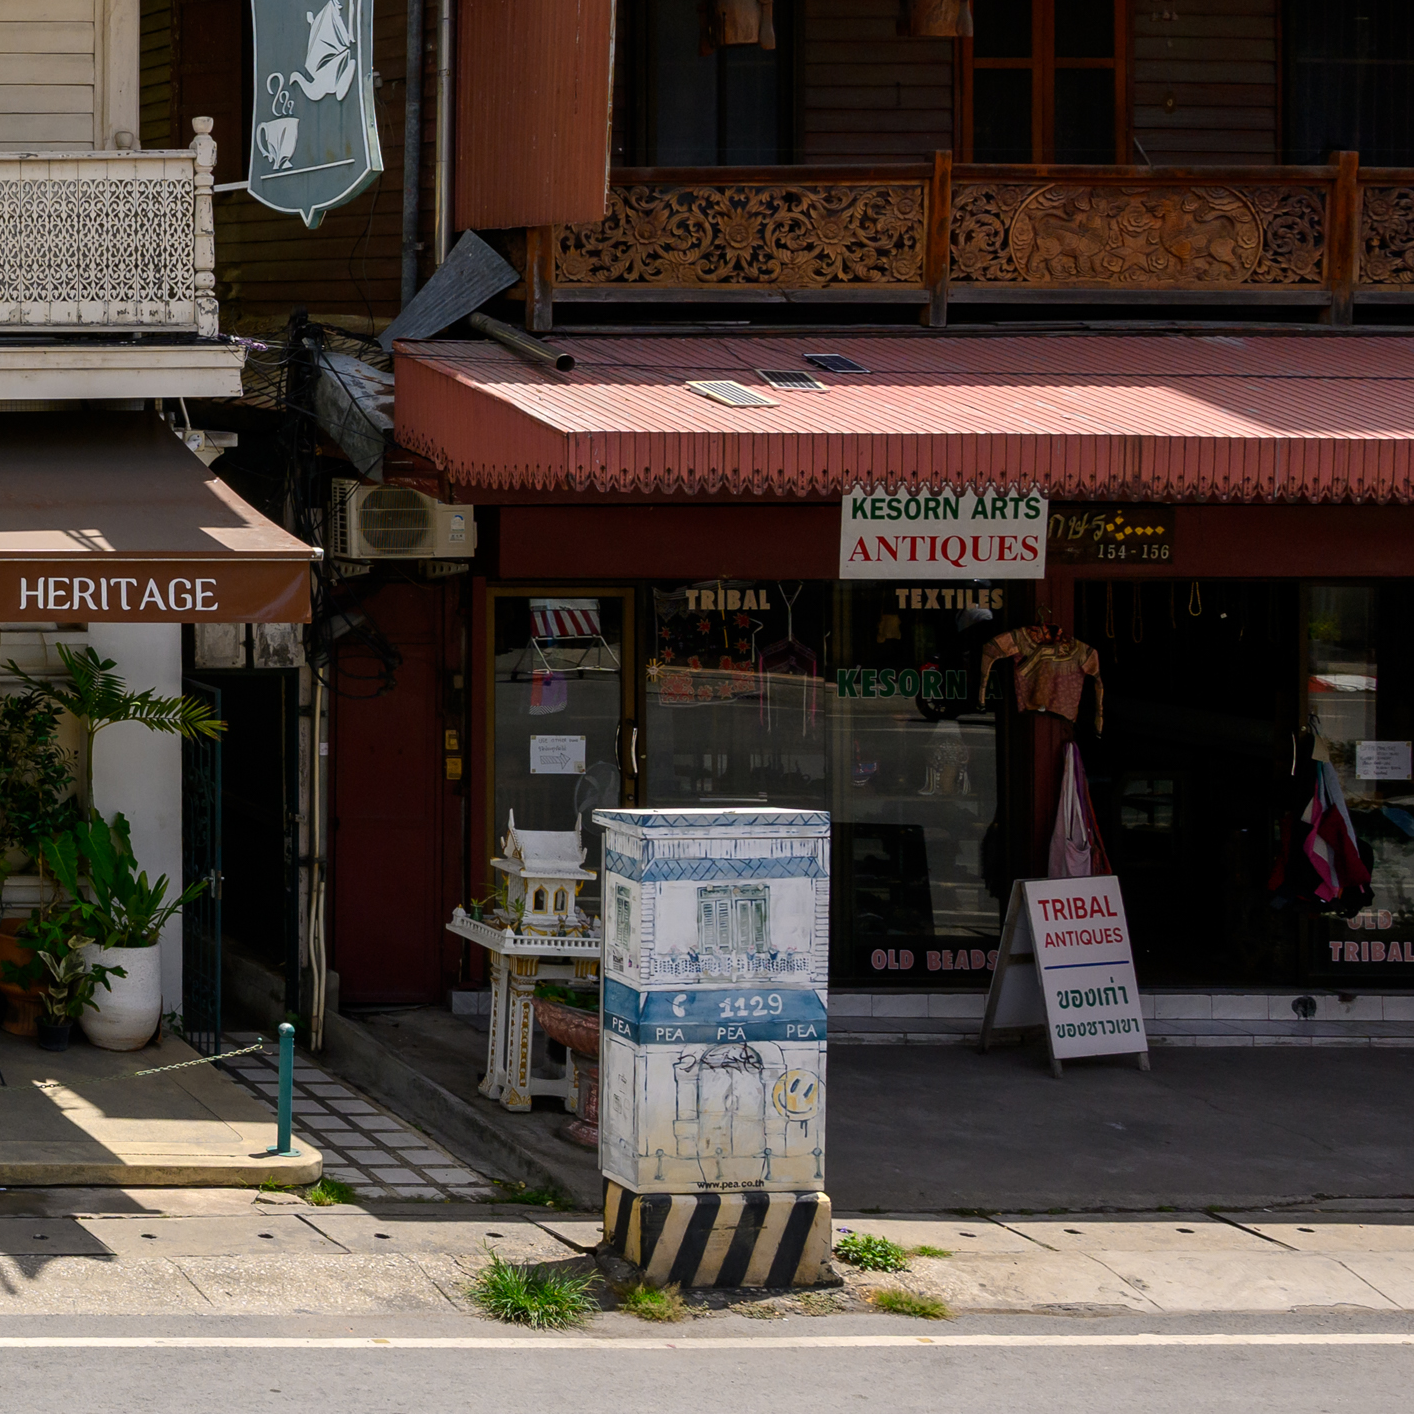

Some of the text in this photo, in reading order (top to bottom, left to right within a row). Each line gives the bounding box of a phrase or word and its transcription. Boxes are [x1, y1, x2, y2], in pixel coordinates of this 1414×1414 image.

[852, 496, 1041, 520] KESORN ARTS
[848, 534, 1039, 568] ANTIQUES
[19, 577, 219, 611] HERITAGE
[685, 587, 1004, 611] TRIBAL TEXTILES
[836, 668, 968, 700] KESORN
[1037, 895, 1118, 922] TRIBAL
[1044, 927, 1125, 949] ANTIQUES
[870, 948, 1000, 972] OLD BEADS
[1329, 941, 1414, 962] TRIBAL
[1056, 976, 1130, 1010] ของเก่า
[719, 993, 784, 1018] 1129
[612, 1016, 632, 1037] PEA
[656, 1023, 818, 1042] PEA PEA PEA
[1055, 1017, 1140, 1039] ของชาวเขา
[696, 1178, 766, 1191] www.pea.co.th
